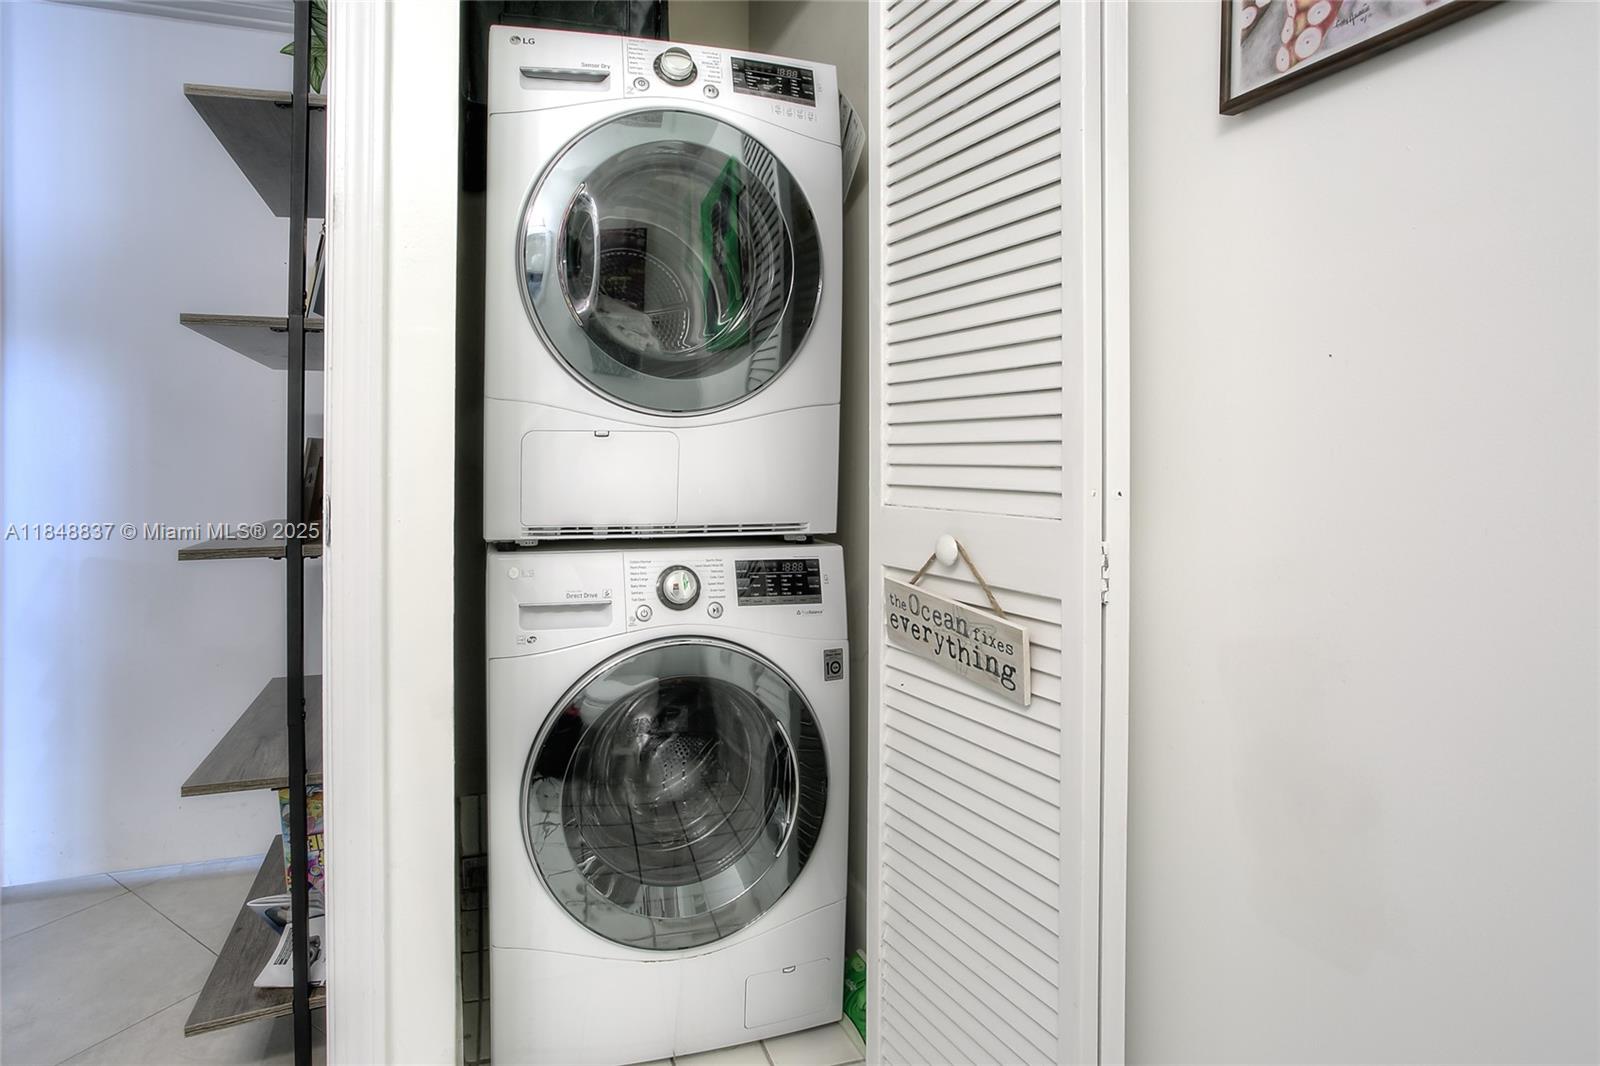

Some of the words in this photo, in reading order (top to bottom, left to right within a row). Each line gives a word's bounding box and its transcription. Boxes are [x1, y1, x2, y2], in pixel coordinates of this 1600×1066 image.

[522, 37, 536, 45] LG
[889, 593, 907, 611] the
[908, 594, 970, 639] Ocean
[973, 627, 1014, 656] fixes
[890, 612, 1017, 691] everything
